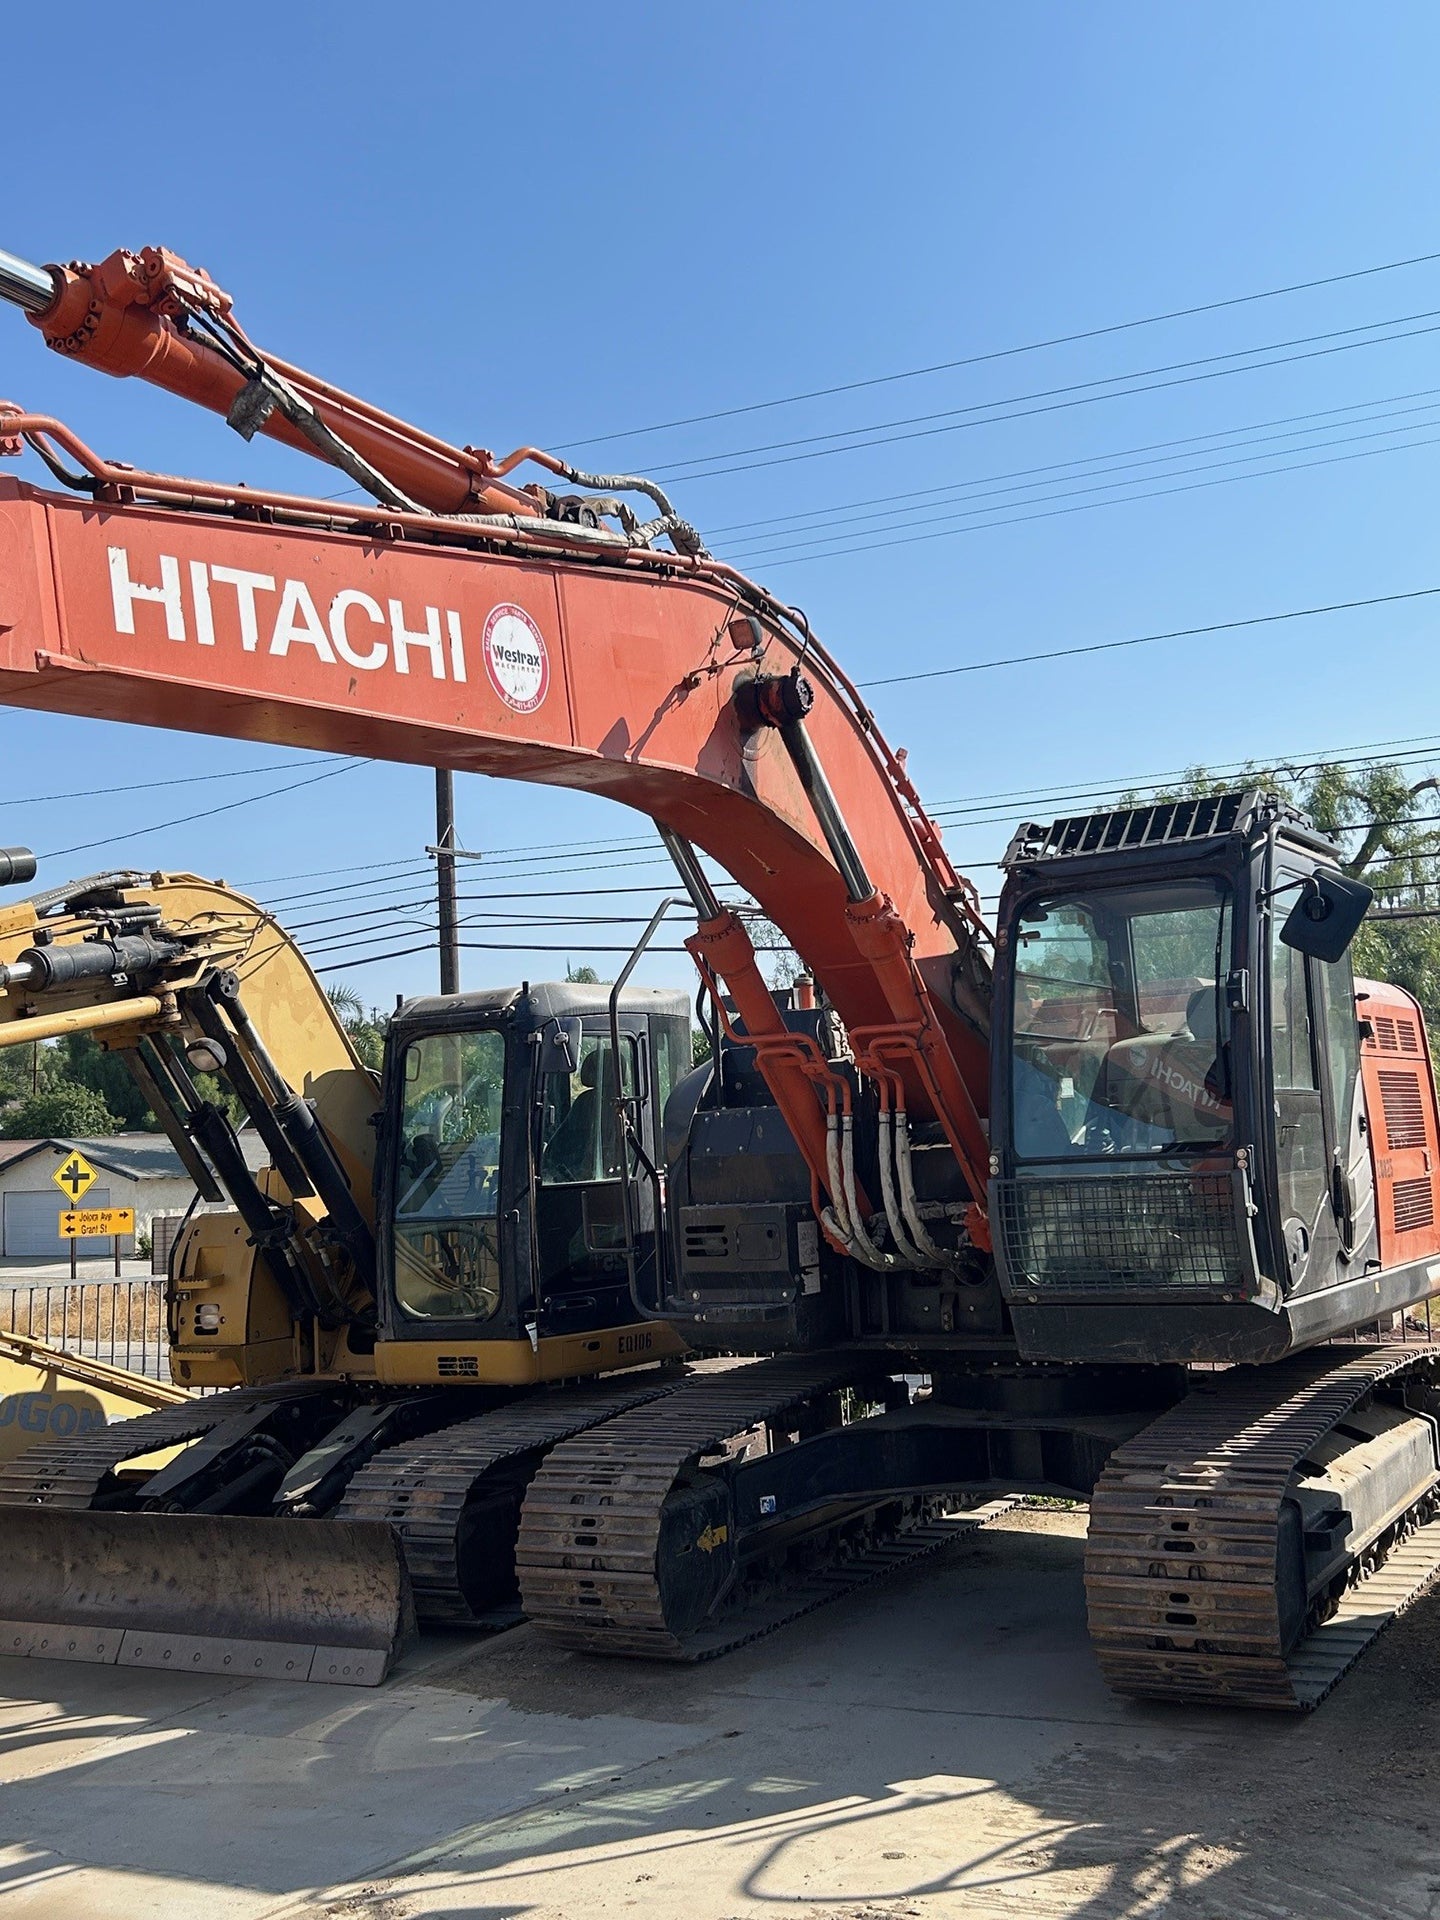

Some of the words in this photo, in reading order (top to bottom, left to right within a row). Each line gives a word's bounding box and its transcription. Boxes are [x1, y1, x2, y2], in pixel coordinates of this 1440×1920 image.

[107, 545, 467, 683] HITACHI
[492, 644, 540, 667] Westrax
[494, 661, 541, 674] MACHINERY
[100, 1211, 112, 1222] Ave
[81, 1224, 98, 1235] Grant
[100, 1223, 107, 1234] St
